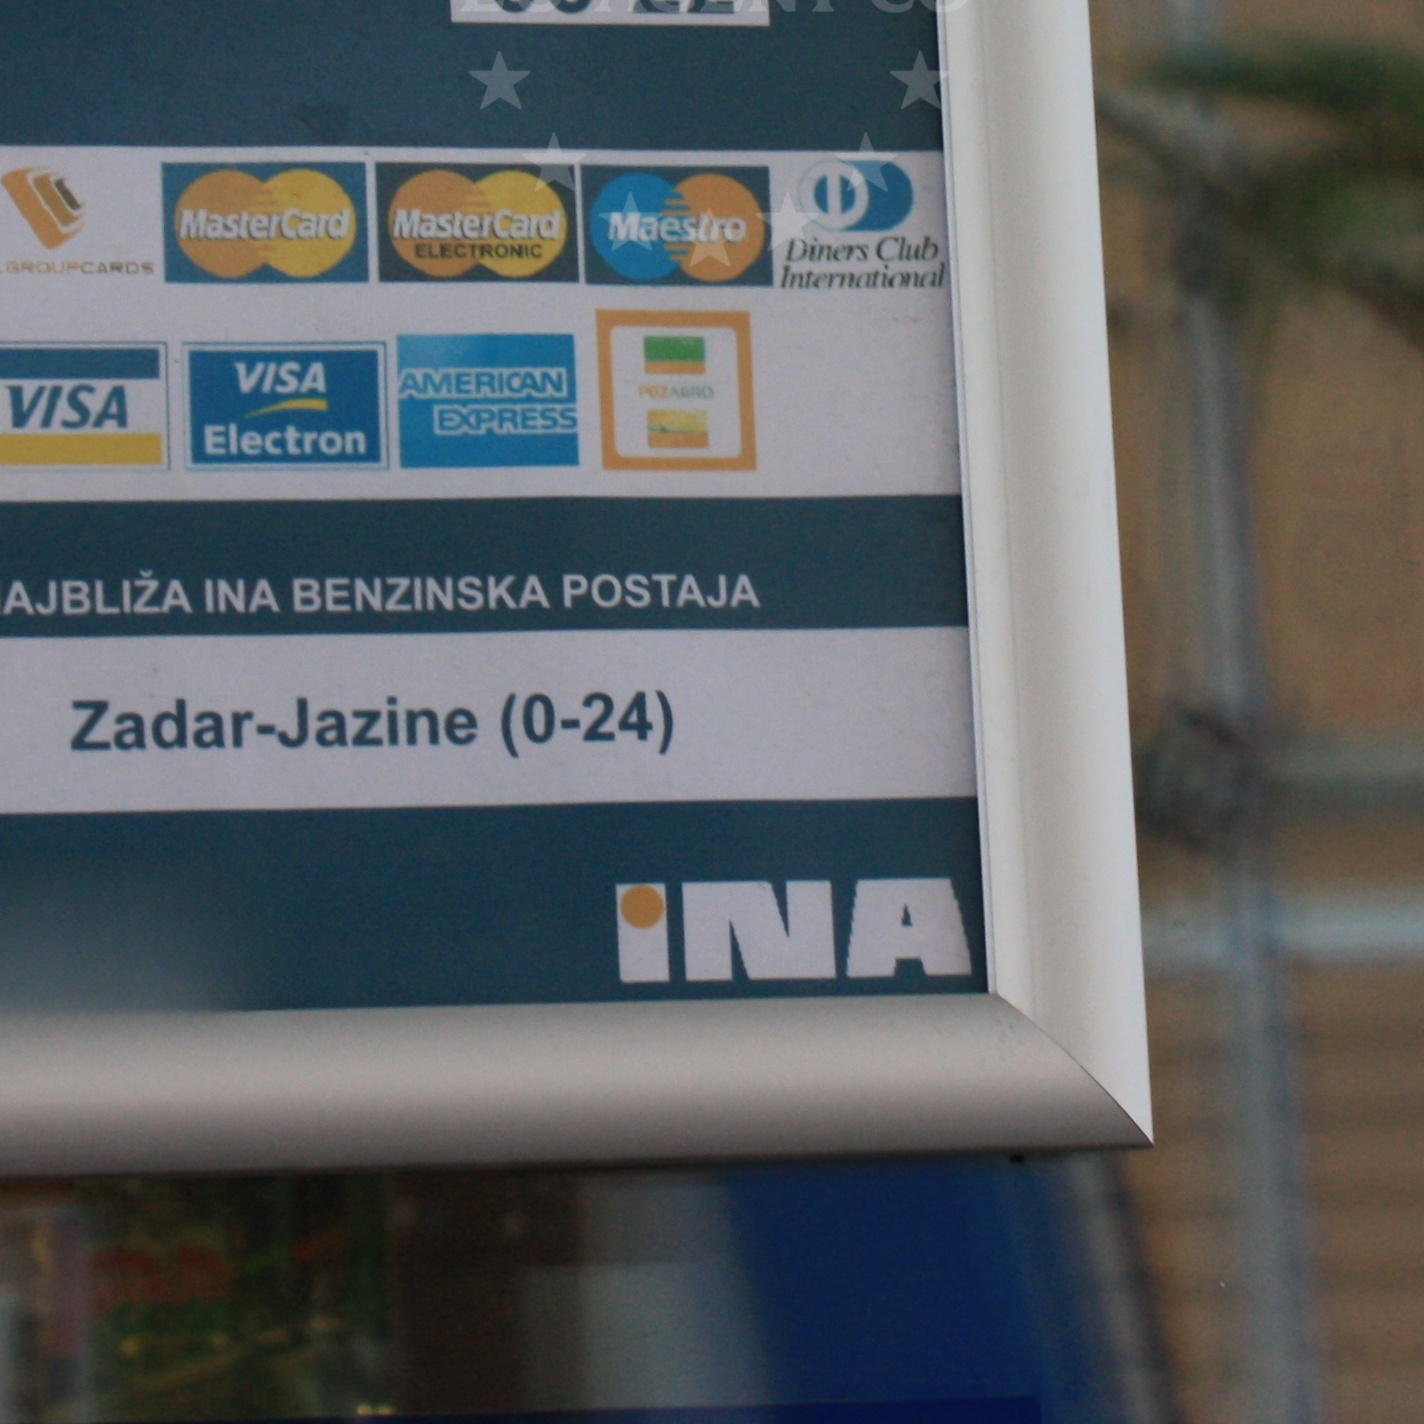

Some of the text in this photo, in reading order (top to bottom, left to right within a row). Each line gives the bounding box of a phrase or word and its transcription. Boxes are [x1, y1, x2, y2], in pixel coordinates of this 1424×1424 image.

[180, 208, 352, 241] MasterCard
[393, 208, 562, 241] MasterCard
[608, 212, 747, 243] Maestro
[414, 243, 542, 259] ELECTRONIC
[785, 235, 939, 262] Diners Club
[780, 263, 947, 290] International
[234, 361, 327, 395] VISA
[398, 367, 567, 398] AMERICAN
[3, 384, 129, 430] VISA
[434, 404, 576, 434] EXPRESS
[204, 423, 367, 455] Electron
[203, 580, 280, 613] INA
[292, 575, 551, 612] BENZINSKA
[562, 573, 760, 609] POSTAJA
[69, 690, 675, 757] Zadar-Jazine (0-24)
